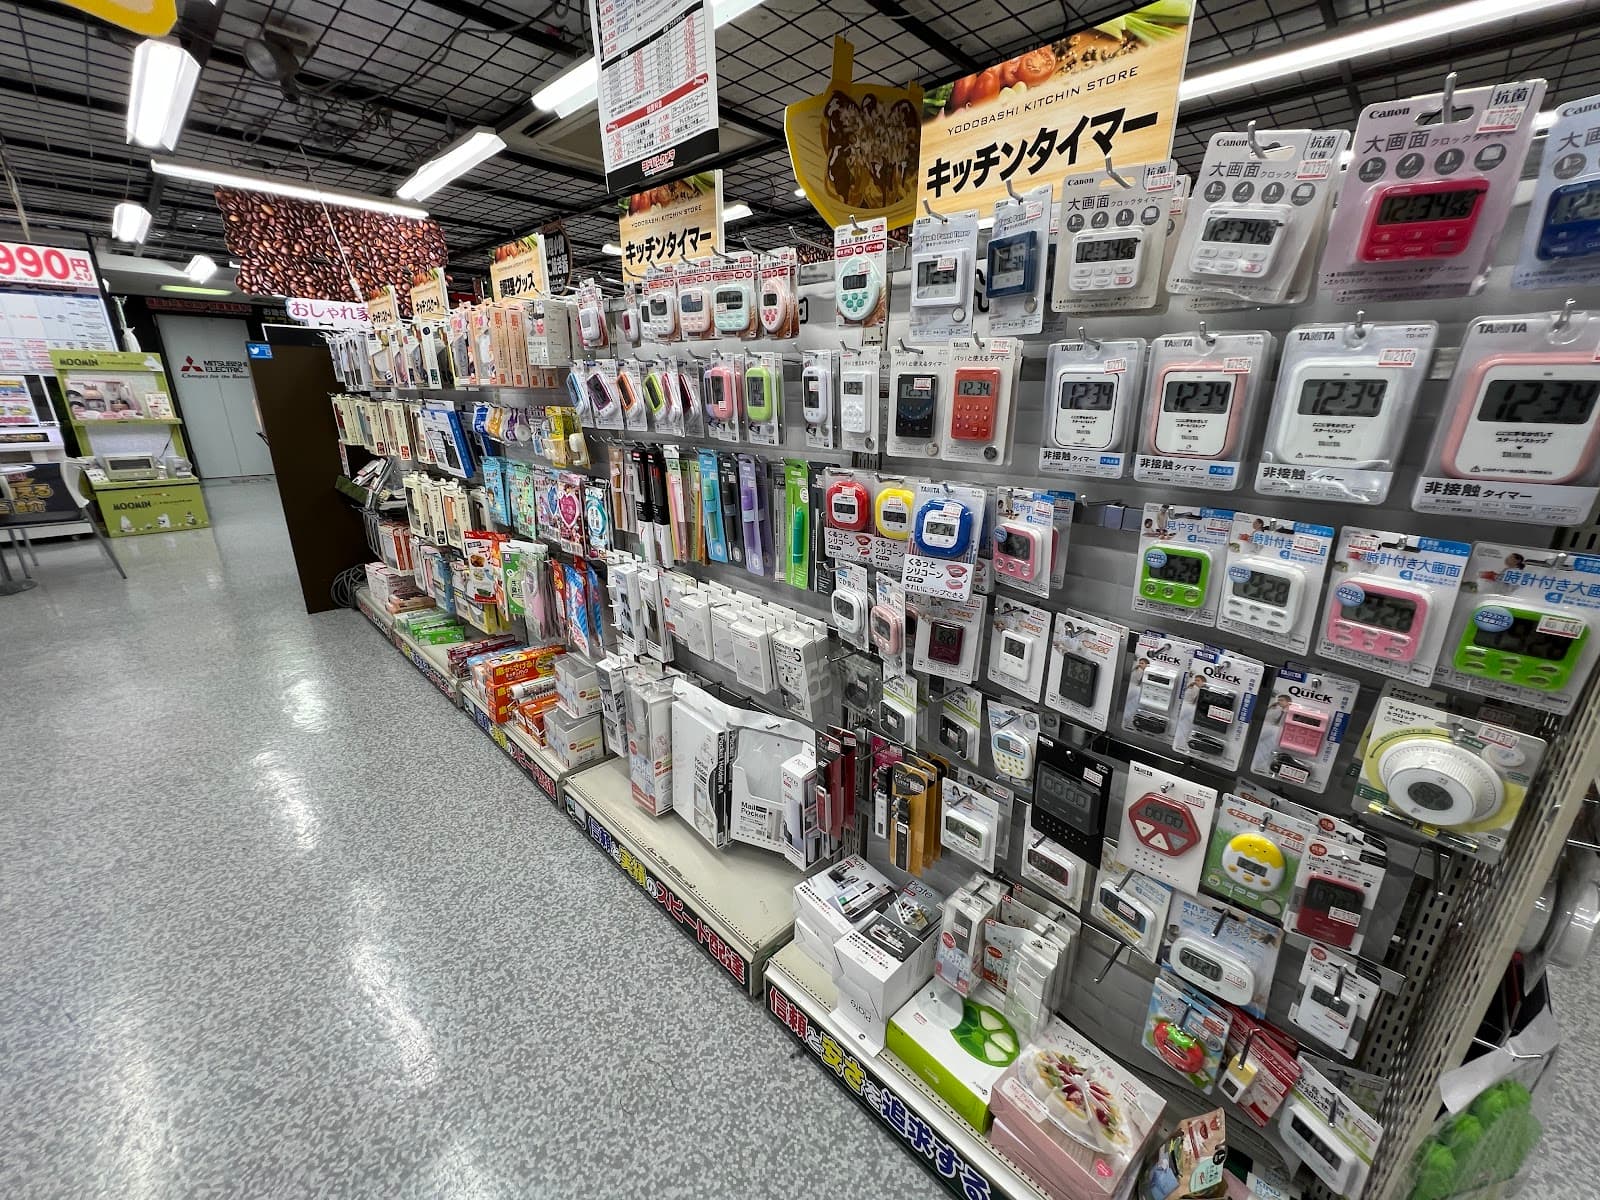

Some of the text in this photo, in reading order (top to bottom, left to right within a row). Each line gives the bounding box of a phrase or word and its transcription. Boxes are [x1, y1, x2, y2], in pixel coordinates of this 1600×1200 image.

[947, 65, 1139, 136] YODOBASHI KITCHIN STORE
[1494, 87, 1529, 104] 抗菌
[1369, 107, 1410, 119] Canon
[1563, 102, 1600, 117] Cano
[1217, 139, 1248, 147] Canon
[1311, 136, 1336, 148] 抗菌
[1363, 130, 1432, 154] 大画面
[927, 108, 1158, 198] キッチンタイマー
[1209, 162, 1262, 177] 大画面
[1067, 177, 1094, 187] Canon
[1067, 194, 1164, 212] 大画面 クロックタイマー
[625, 226, 712, 265] キッチンタイマー
[70, 258, 89, 273] 円
[1298, 331, 1336, 341] TANITA
[60, 358, 99, 367] MOOMIN
[1043, 450, 1071, 461] 非接触
[1140, 458, 1174, 470] 非接触
[1174, 464, 1204, 472] タイマー
[1263, 467, 1306, 480] 非接触
[1424, 481, 1533, 500] 非接触 タイマー
[113, 501, 152, 511] MOOMIN
[828, 531, 849, 540] くるっと
[828, 537, 855, 547] シリコーン
[876, 540, 899, 550] くるっと
[909, 557, 937, 569] くるっと
[1366, 551, 1463, 578] 時計付き大画面
[906, 567, 945, 579] シリコーン
[1203, 666, 1242, 684] Quick
[1288, 685, 1334, 704] Quick
[741, 801, 756, 811] Mail
[741, 808, 766, 820] Pocket
[910, 880, 934, 899] Plate
[850, 999, 872, 1023] Plate
[769, 985, 992, 1200] 信頼と安さを追求する
